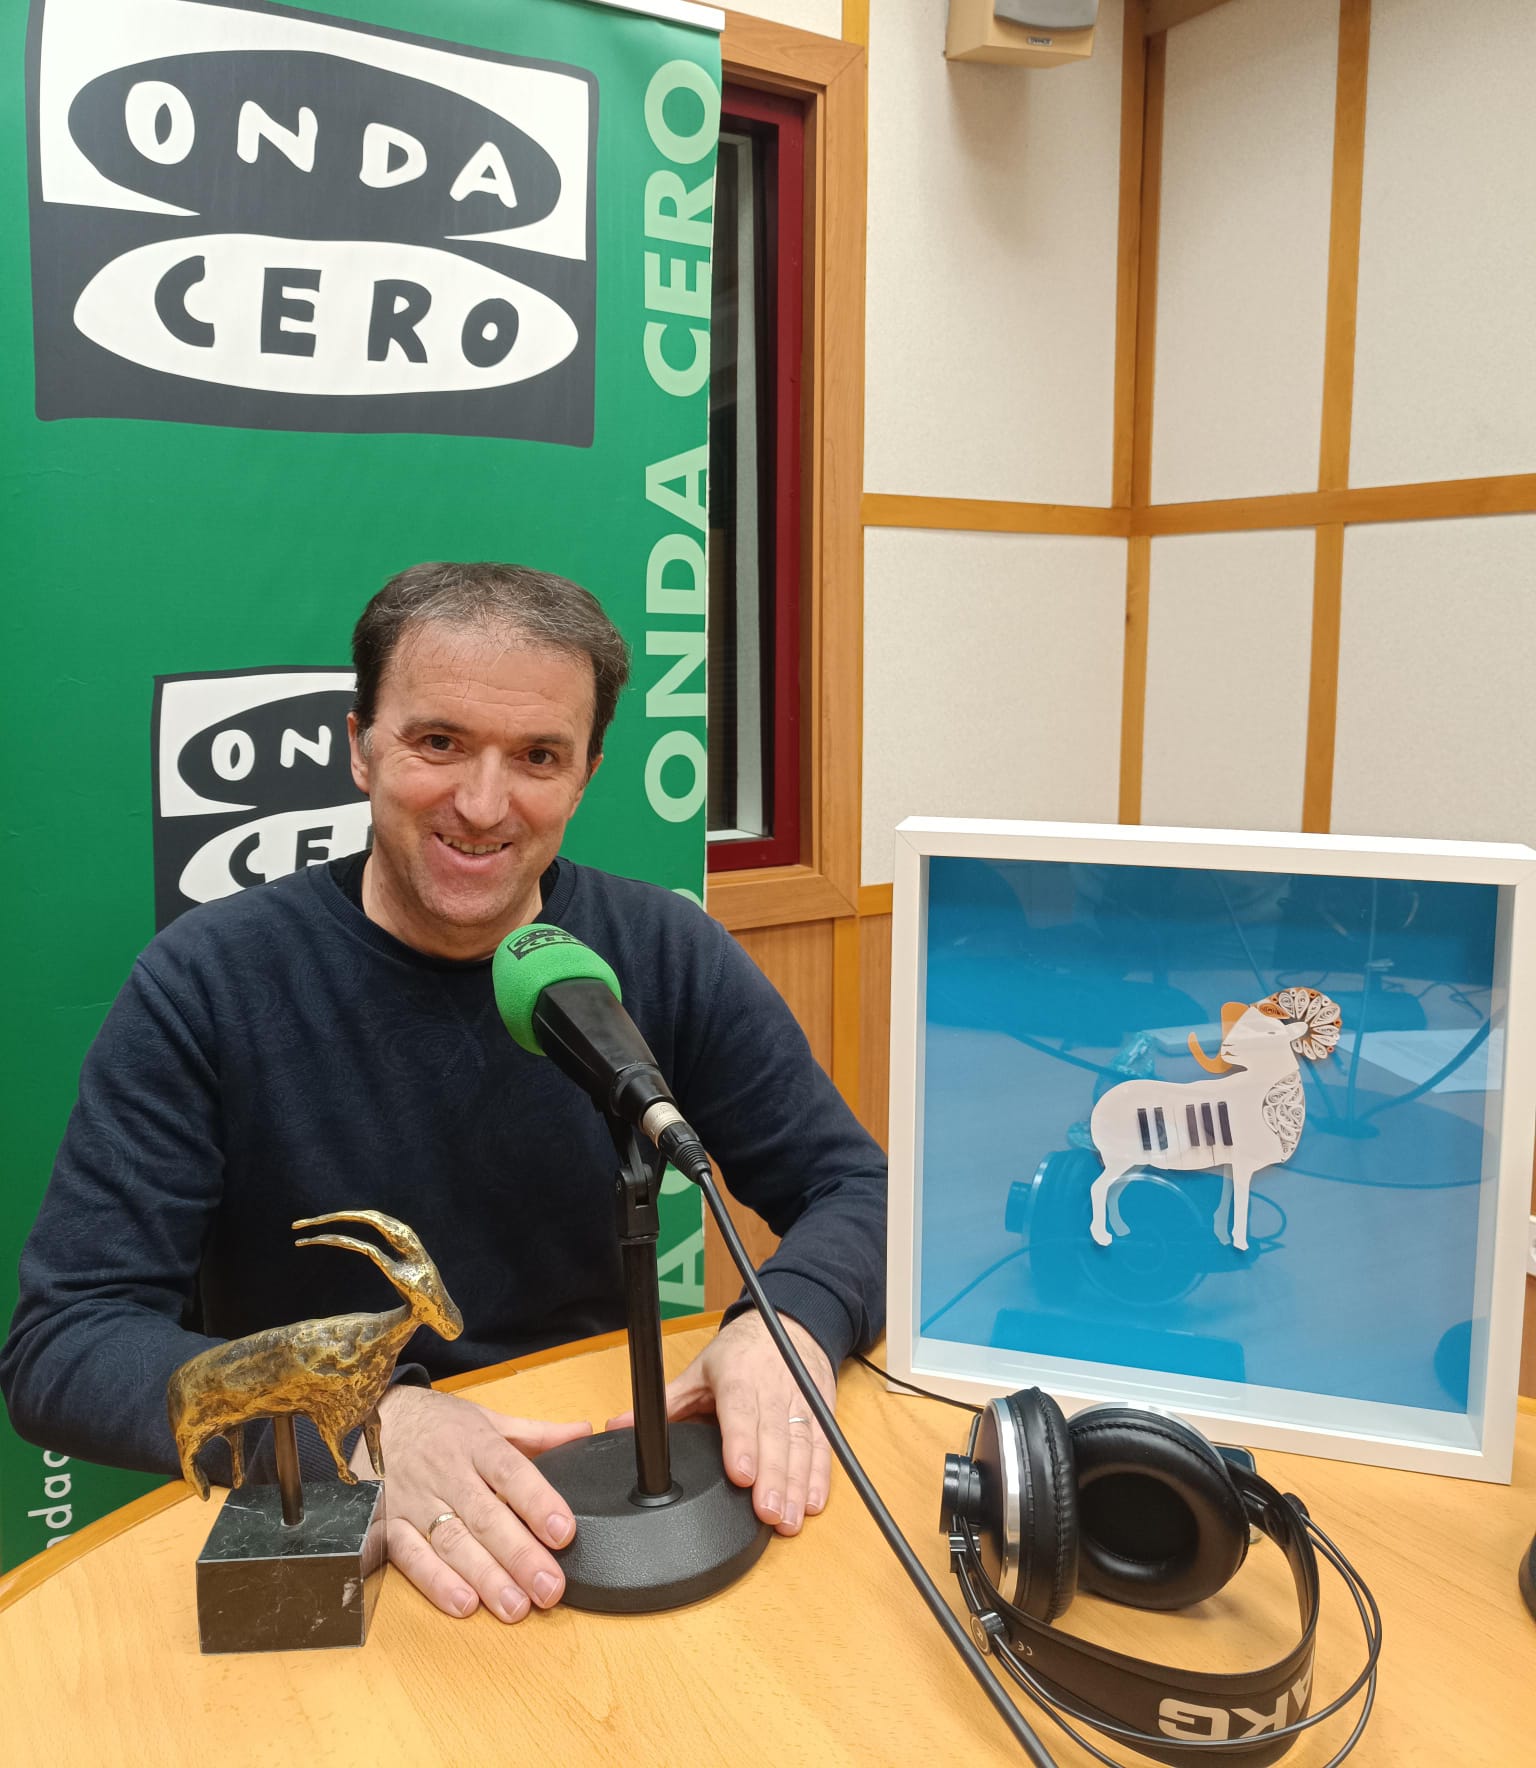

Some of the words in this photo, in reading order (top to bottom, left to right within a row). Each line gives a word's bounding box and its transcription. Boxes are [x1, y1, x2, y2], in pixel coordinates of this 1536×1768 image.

[125, 81, 518, 209] ONDA
[643, 59, 722, 397] CERO
[154, 255, 520, 369] CERO
[644, 443, 708, 823] ONDA
[211, 725, 332, 781] ON
[228, 822, 373, 890] CE
